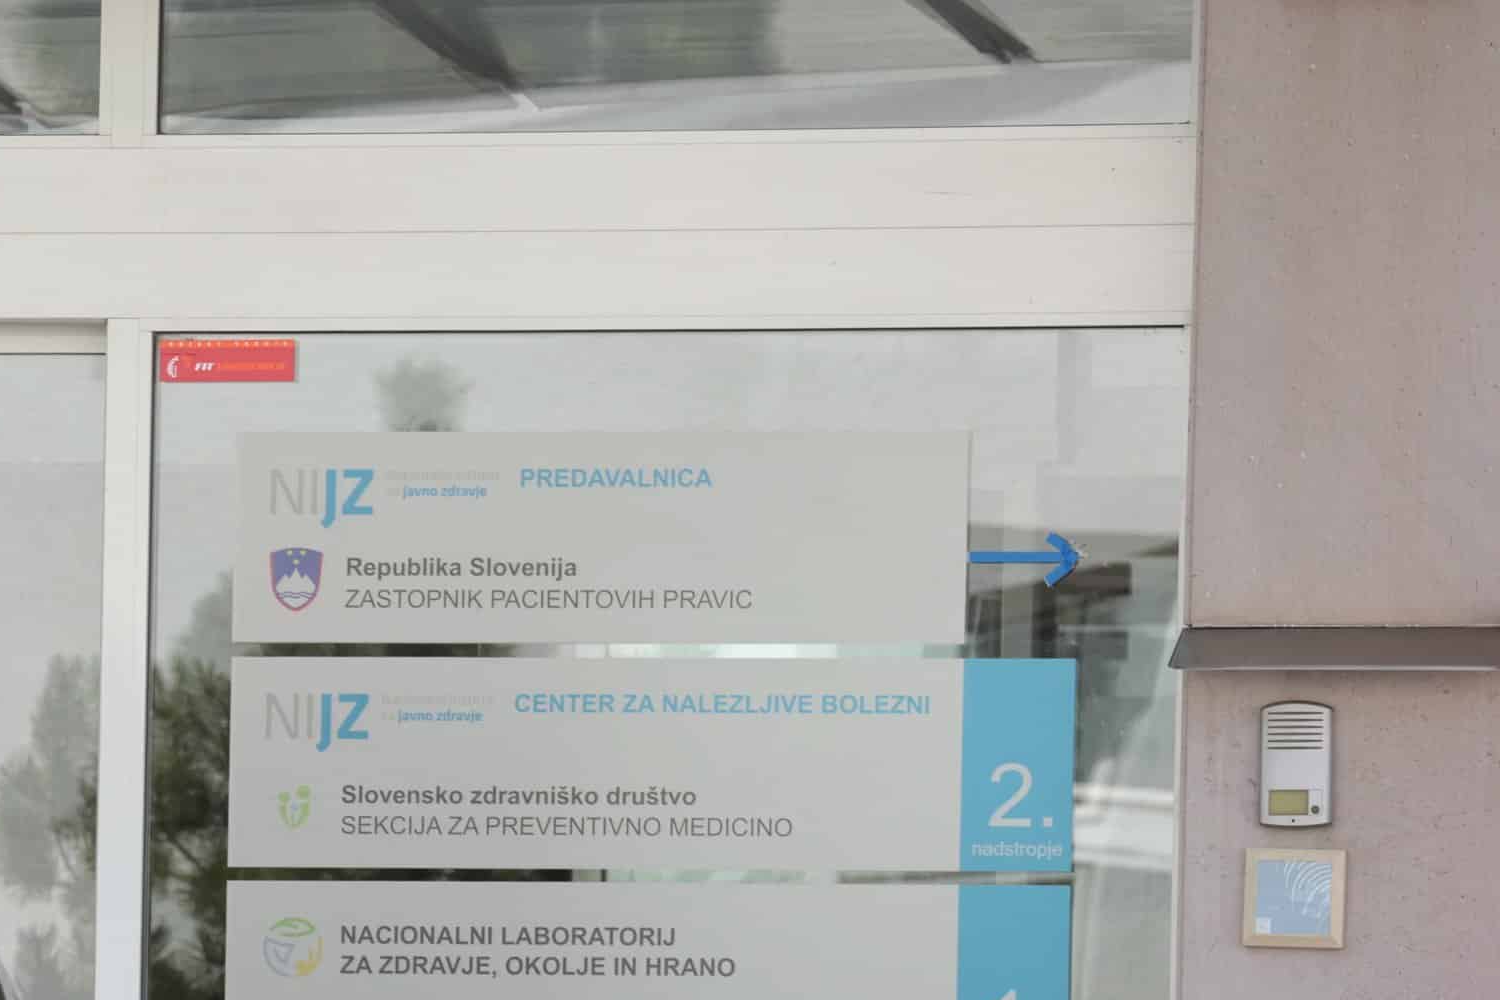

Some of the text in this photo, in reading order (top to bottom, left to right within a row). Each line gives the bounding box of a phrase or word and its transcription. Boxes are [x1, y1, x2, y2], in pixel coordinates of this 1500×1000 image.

[520, 467, 711, 488] PREDAVALNICA
[269, 468, 374, 528] NIJZ
[347, 557, 576, 582] Republika Slovenija
[345, 588, 753, 609] ZASTOPNIK PACIENTOVIH PRAVIC
[515, 694, 614, 714] CENTER
[621, 694, 654, 714] ZA
[662, 694, 812, 715] NALEZLJIVE
[820, 695, 930, 716] BOLEZNI
[264, 692, 371, 752] NIJZ
[342, 785, 697, 807] Slovensko zdravniško društvo
[988, 762, 1054, 829] 2.
[341, 816, 793, 838] SEKCIJA ZA PREVENTIVNO MEDICINO
[971, 839, 1063, 859] nadstropje
[341, 925, 676, 947] NACIONALNI LABORATORIJ
[340, 955, 737, 979] ZA ZDRAVJE, OKOLJE IN HRANO
